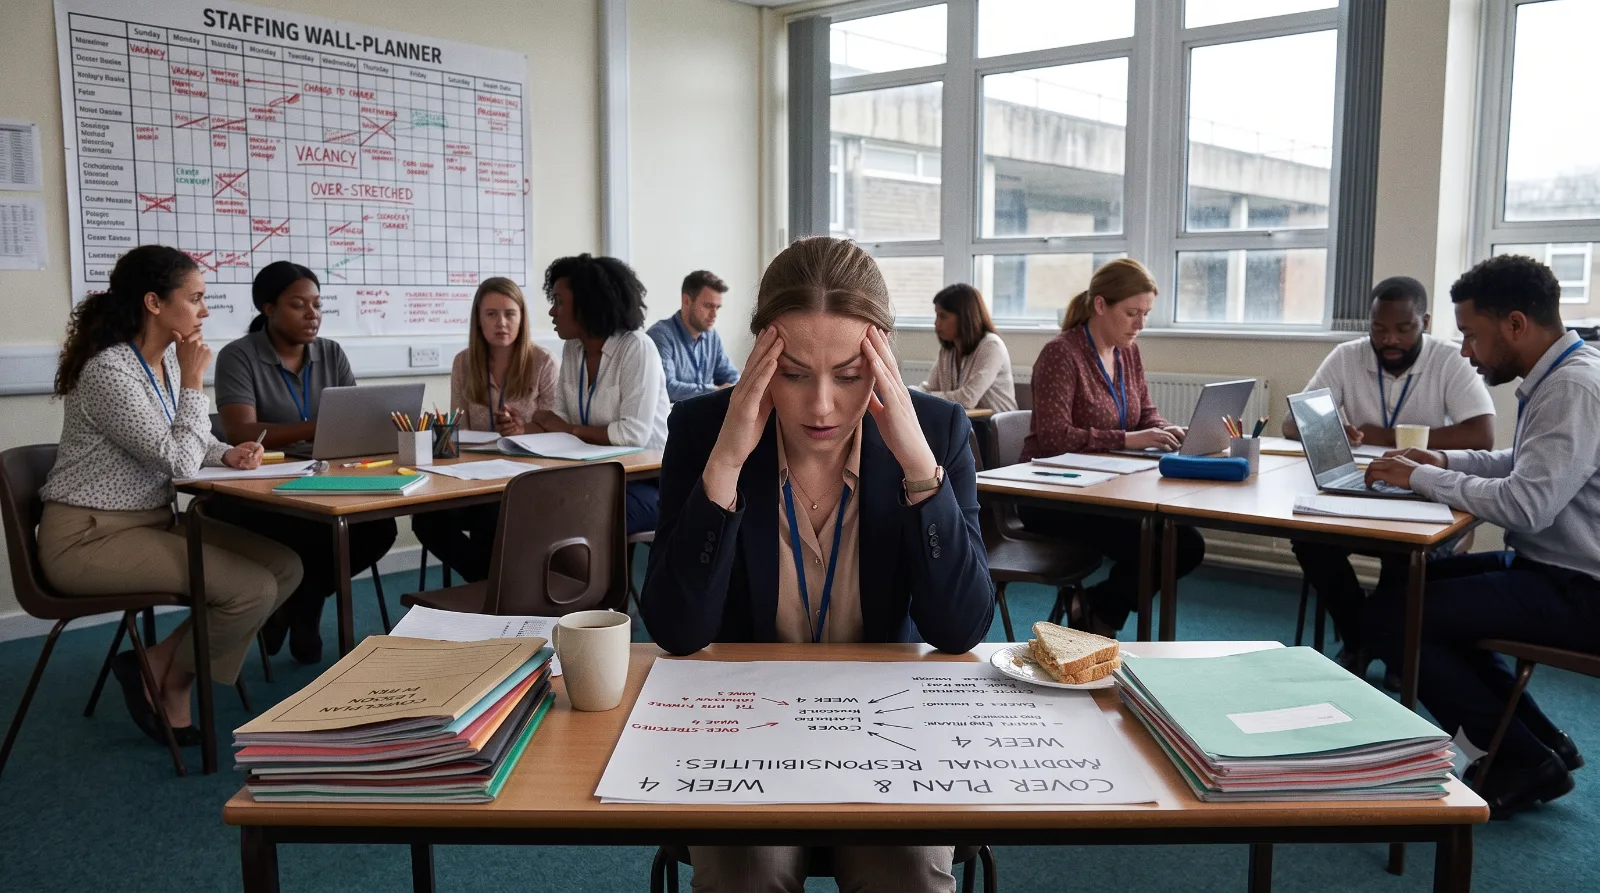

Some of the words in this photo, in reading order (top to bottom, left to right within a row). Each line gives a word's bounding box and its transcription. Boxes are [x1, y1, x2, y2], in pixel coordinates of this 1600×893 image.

[134, 28, 161, 40] Sunday
[173, 34, 201, 45] Monday
[203, 8, 299, 41] STAFFING
[304, 25, 442, 64] WALL-PLANNER
[129, 43, 166, 60] VACANCY
[171, 65, 204, 79] VACANCY
[295, 145, 357, 166] VACANCY
[311, 181, 413, 200] OVER-STRETCHED
[951, 736, 972, 748] 4
[984, 737, 1064, 748] WEEK
[639, 776, 660, 792] 4
[676, 778, 765, 793] WEEK
[873, 780, 892, 793] &
[913, 779, 993, 793] PLAN
[1008, 779, 1114, 793] COVER
